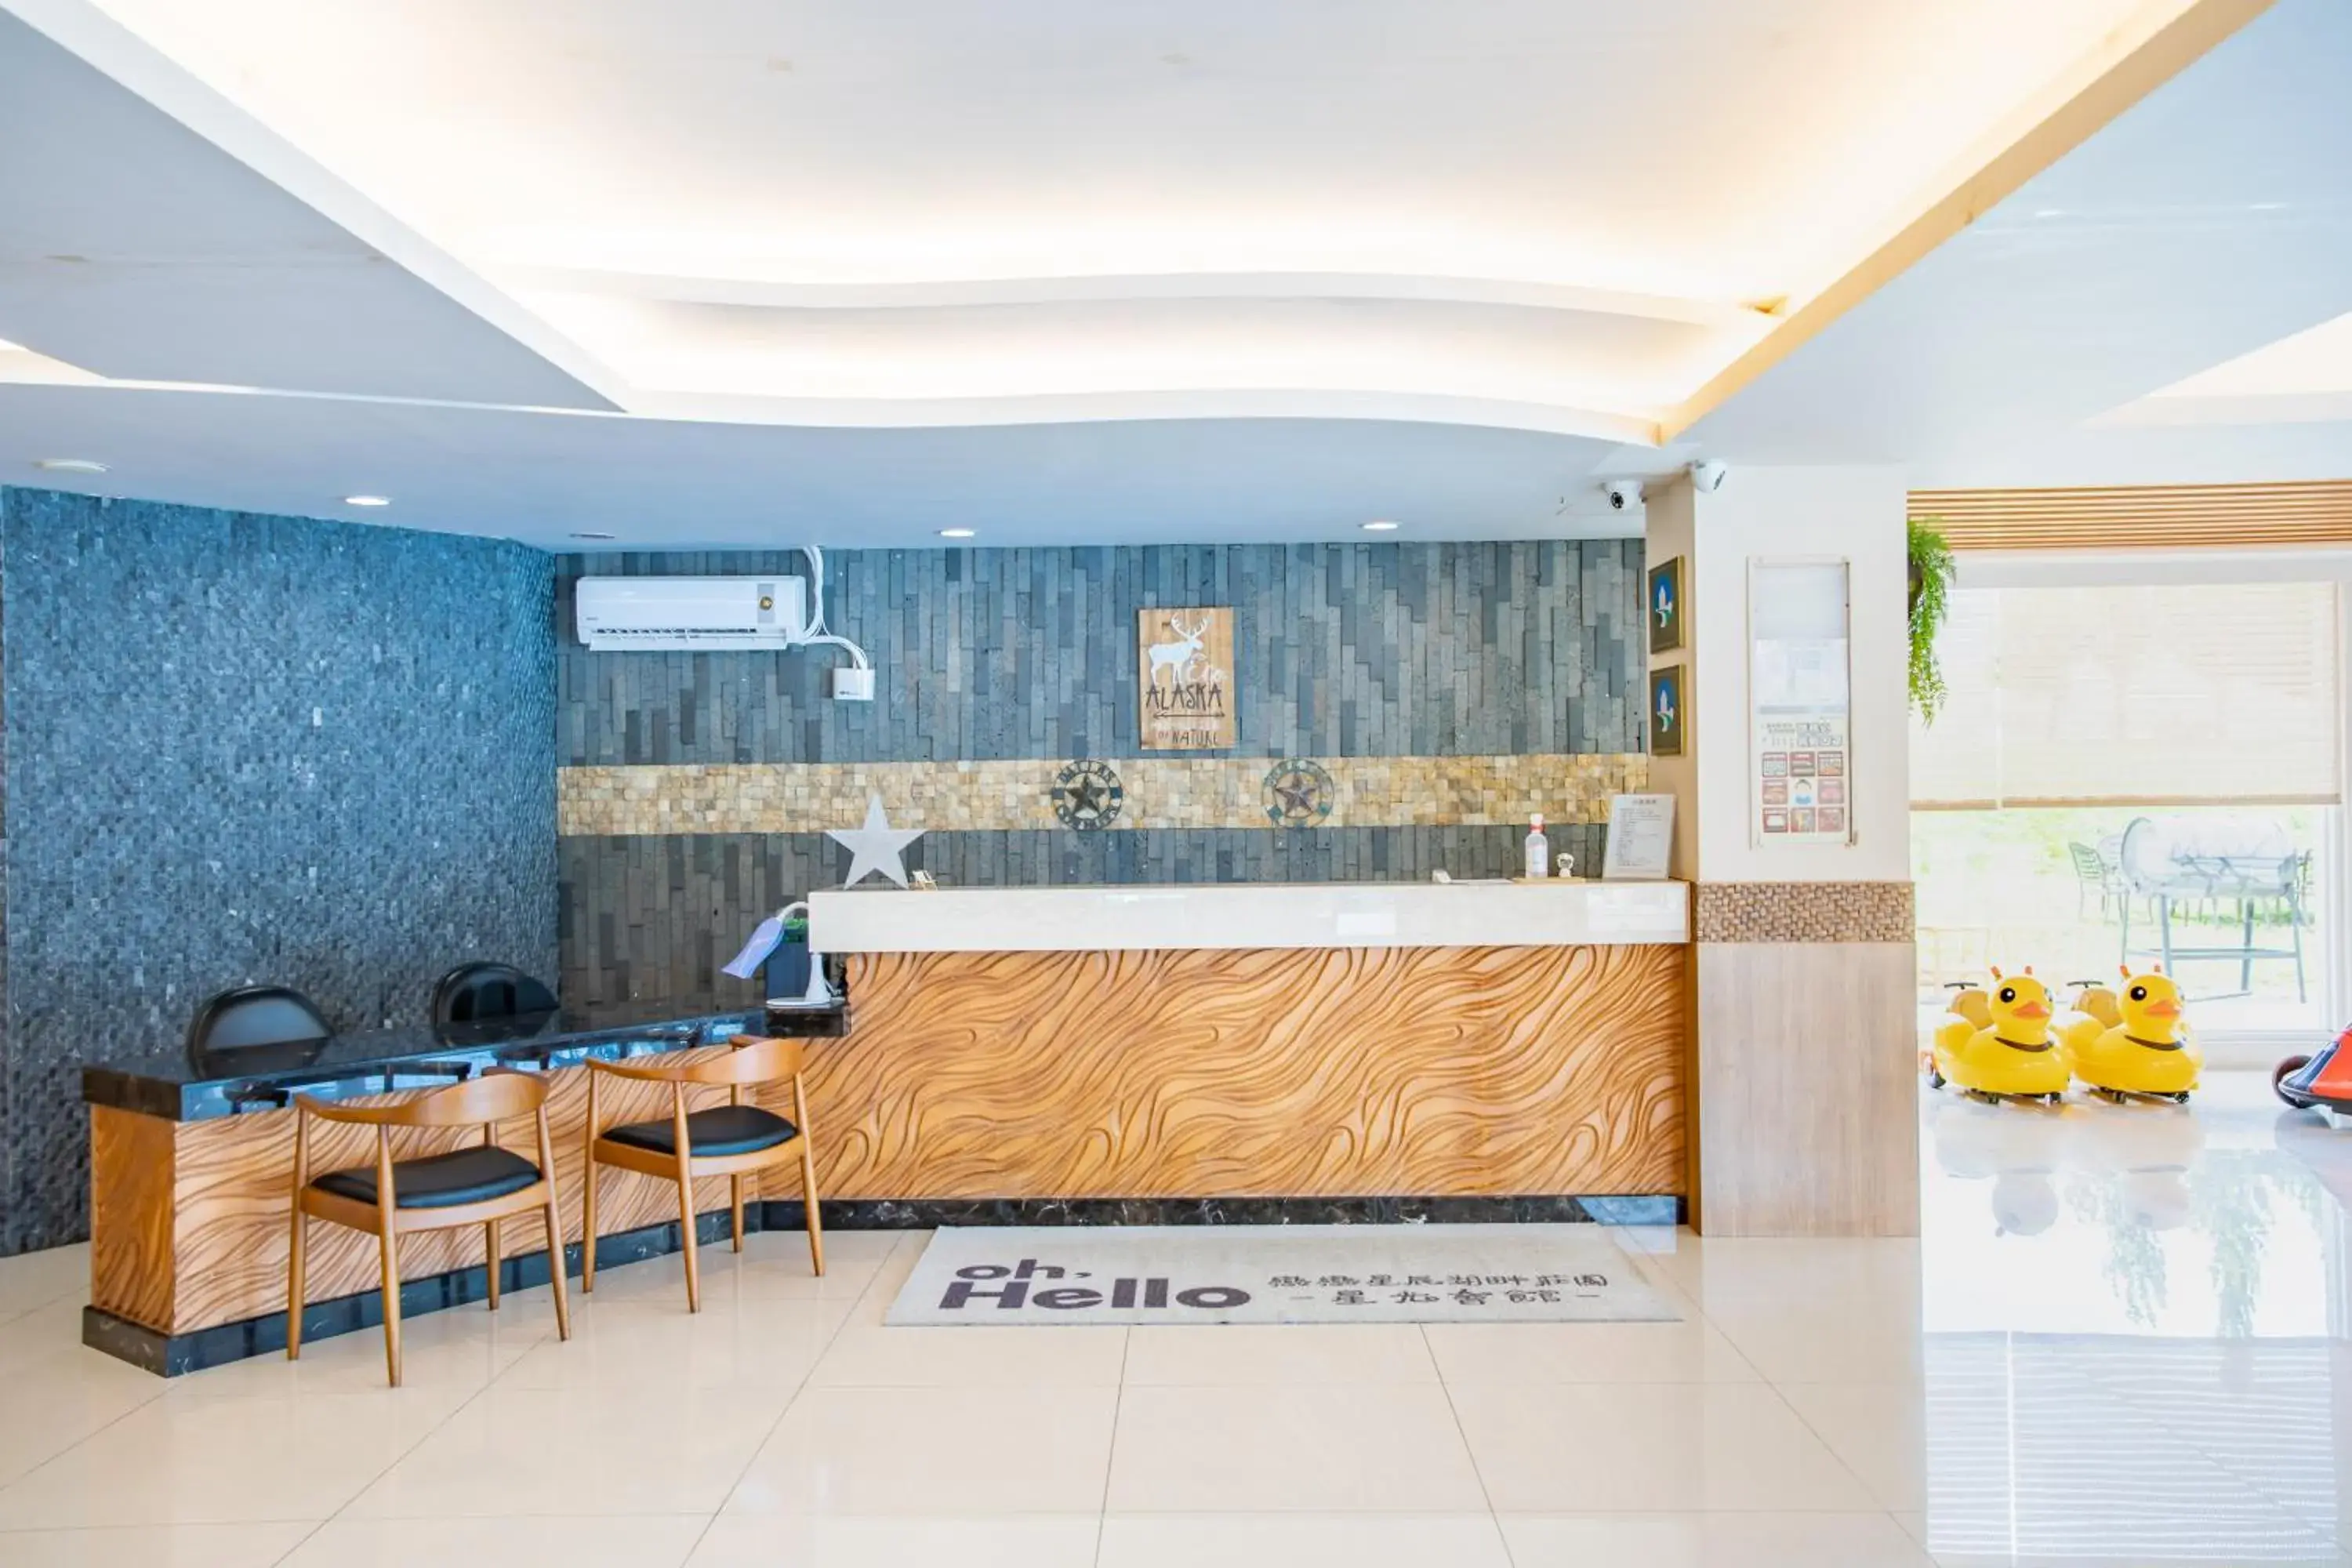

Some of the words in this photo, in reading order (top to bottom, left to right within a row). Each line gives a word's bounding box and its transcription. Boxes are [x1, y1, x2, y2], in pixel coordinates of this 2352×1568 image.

[1145, 683, 1221, 710] ALASKA
[956, 1258, 1092, 1279] oh,
[938, 1278, 1252, 1310] Hello
